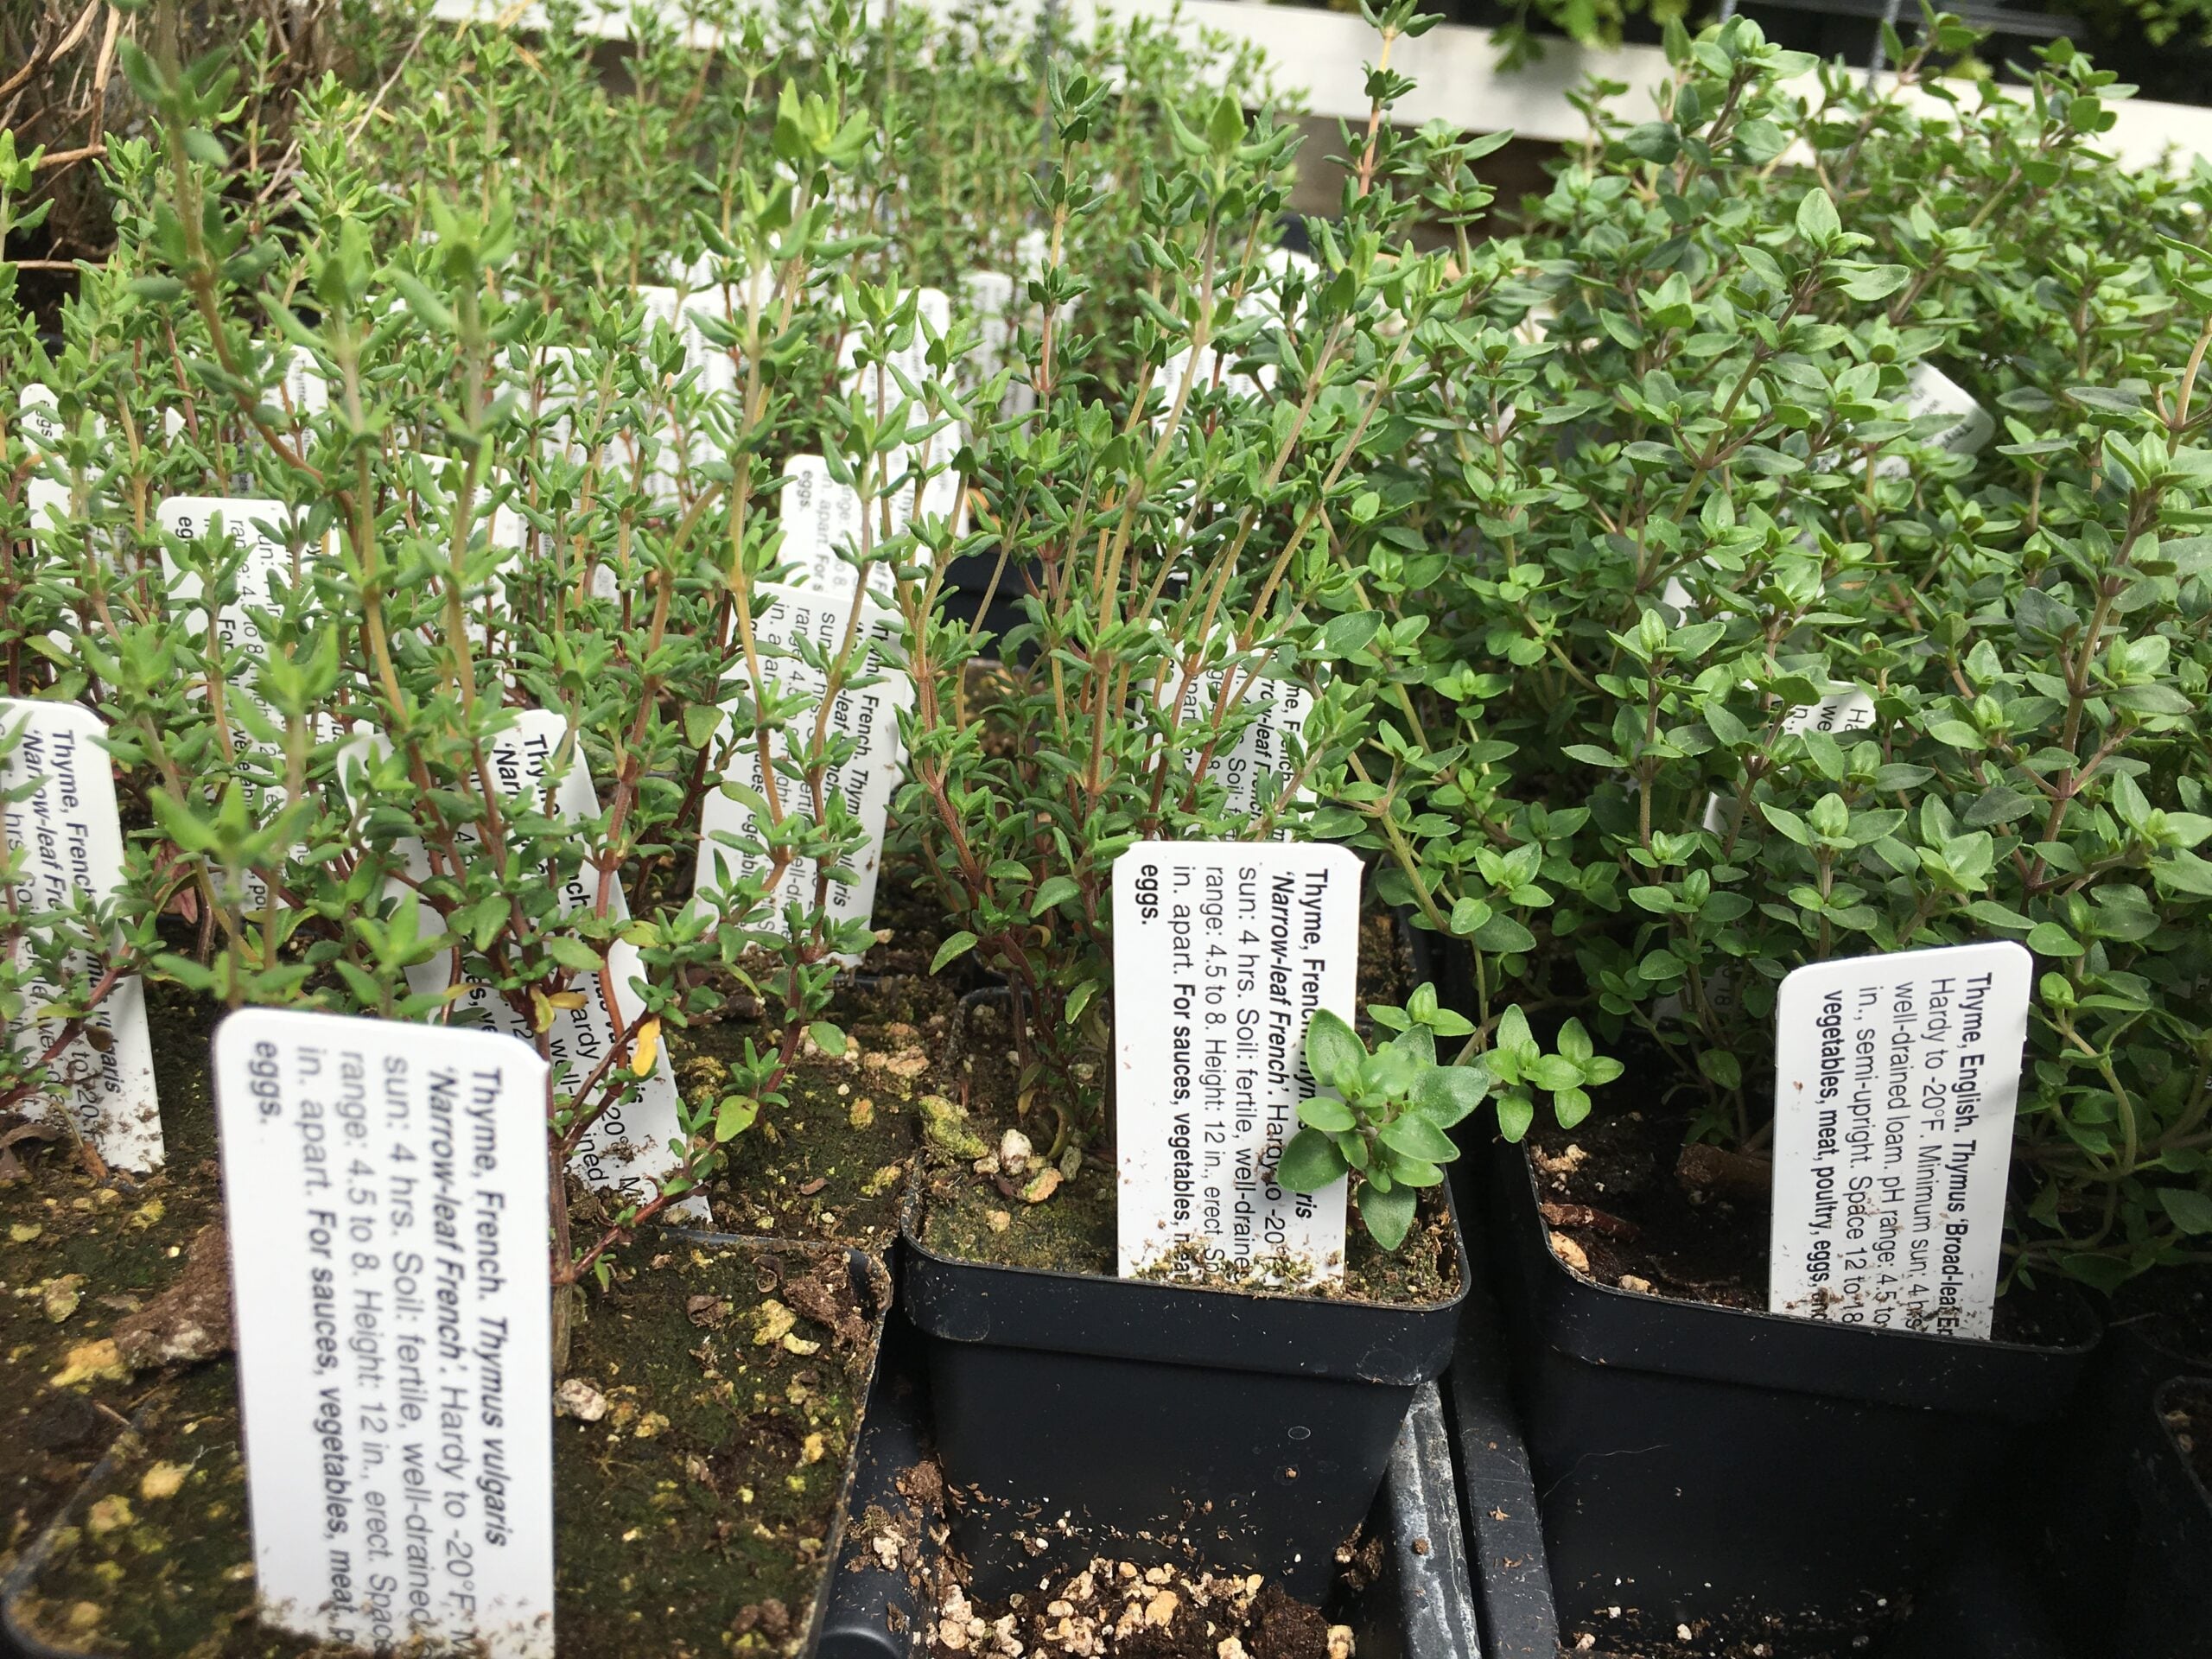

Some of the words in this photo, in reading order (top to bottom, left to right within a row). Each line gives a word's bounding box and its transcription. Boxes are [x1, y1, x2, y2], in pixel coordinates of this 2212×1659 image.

[796, 470, 813, 512] eggs.
[853, 694, 880, 760] French.
[49, 729, 79, 814] Thyme,
[1135, 864, 1159, 925] eggs.
[1173, 866, 1196, 894] in.
[1199, 867, 1224, 936] range:
[1237, 867, 1256, 920] sun:
[1298, 868, 1328, 950] Thyme,
[1167, 904, 1194, 975] apart.
[1205, 944, 1227, 978] 4.5
[1237, 930, 1261, 945] 4
[1269, 870, 1295, 1007] 'Narrow-leaf
[1173, 983, 1196, 1020] For
[1205, 985, 1226, 1005] to
[1237, 954, 1261, 999] hrs.
[1853, 985, 1885, 1021] in.,
[1920, 977, 1956, 1042] Hardy
[1205, 1011, 1227, 1030] 8.
[1236, 1007, 1260, 1059] Soil:
[1956, 971, 1993, 1049] Thyme,
[295, 1046, 327, 1086] in.
[1170, 1026, 1192, 1106] sauces,
[1198, 1039, 1227, 1111] Height:
[1268, 1010, 1292, 1096] French'.
[1815, 989, 1846, 1105] vegetables,
[1886, 980, 1918, 1110] well-drained
[1924, 1049, 1948, 1071] to
[247, 1039, 283, 1126] eggs.
[335, 1050, 369, 1147] range:
[383, 1056, 411, 1128] sun:
[1231, 1069, 1259, 1139] fertile,
[1844, 1027, 1879, 1169] semi-upright.
[1951, 1053, 1986, 1133] English.
[294, 1099, 333, 1198] apart.
[388, 1142, 418, 1163] 4
[465, 1065, 502, 1179] Thyme,
[1204, 1121, 1226, 1144] 12
[1811, 1109, 1840, 1162] meat,
[1882, 1115, 1912, 1171] loam.
[346, 1159, 378, 1207] 4.5
[427, 1065, 465, 1255] 'Narrow-leaf
[1168, 1111, 1195, 1227] vegetables,
[1200, 1151, 1226, 1179] in.,
[1877, 1175, 1906, 1205] pH
[1911, 1144, 1943, 1234] Minimum
[1944, 1139, 1977, 1212] Thymus
[307, 1208, 339, 1260] For
[349, 1215, 378, 1243] to
[390, 1175, 420, 1237] hrs.
[1808, 1166, 1839, 1236] poultry,
[1842, 1175, 1873, 1241] Space
[351, 1252, 380, 1277] 8.
[475, 1188, 508, 1301] French.
[1805, 1239, 1833, 1288] eggs,
[1844, 1246, 1868, 1272] 12
[1872, 1209, 1899, 1269] range:
[1907, 1238, 1929, 1279] sun:
[392, 1250, 426, 1320] Soil:
[434, 1257, 469, 1375] French'.
[1840, 1301, 1865, 1324] 18
[1843, 1274, 1866, 1295] to
[1873, 1306, 1896, 1325] to
[310, 1268, 340, 1376] sauces,
[348, 1289, 390, 1389] Height:
[396, 1332, 429, 1431] fertile,
[473, 1315, 509, 1429] Thymus
[359, 1402, 389, 1435] 12
[435, 1384, 470, 1481] Hardy
[313, 1387, 356, 1541] vegetables,
[359, 1440, 391, 1482] in.,
[476, 1438, 514, 1548] vulgaris
[364, 1490, 394, 1564] erect.
[403, 1441, 438, 1628] well-drained
[443, 1490, 471, 1519] to
